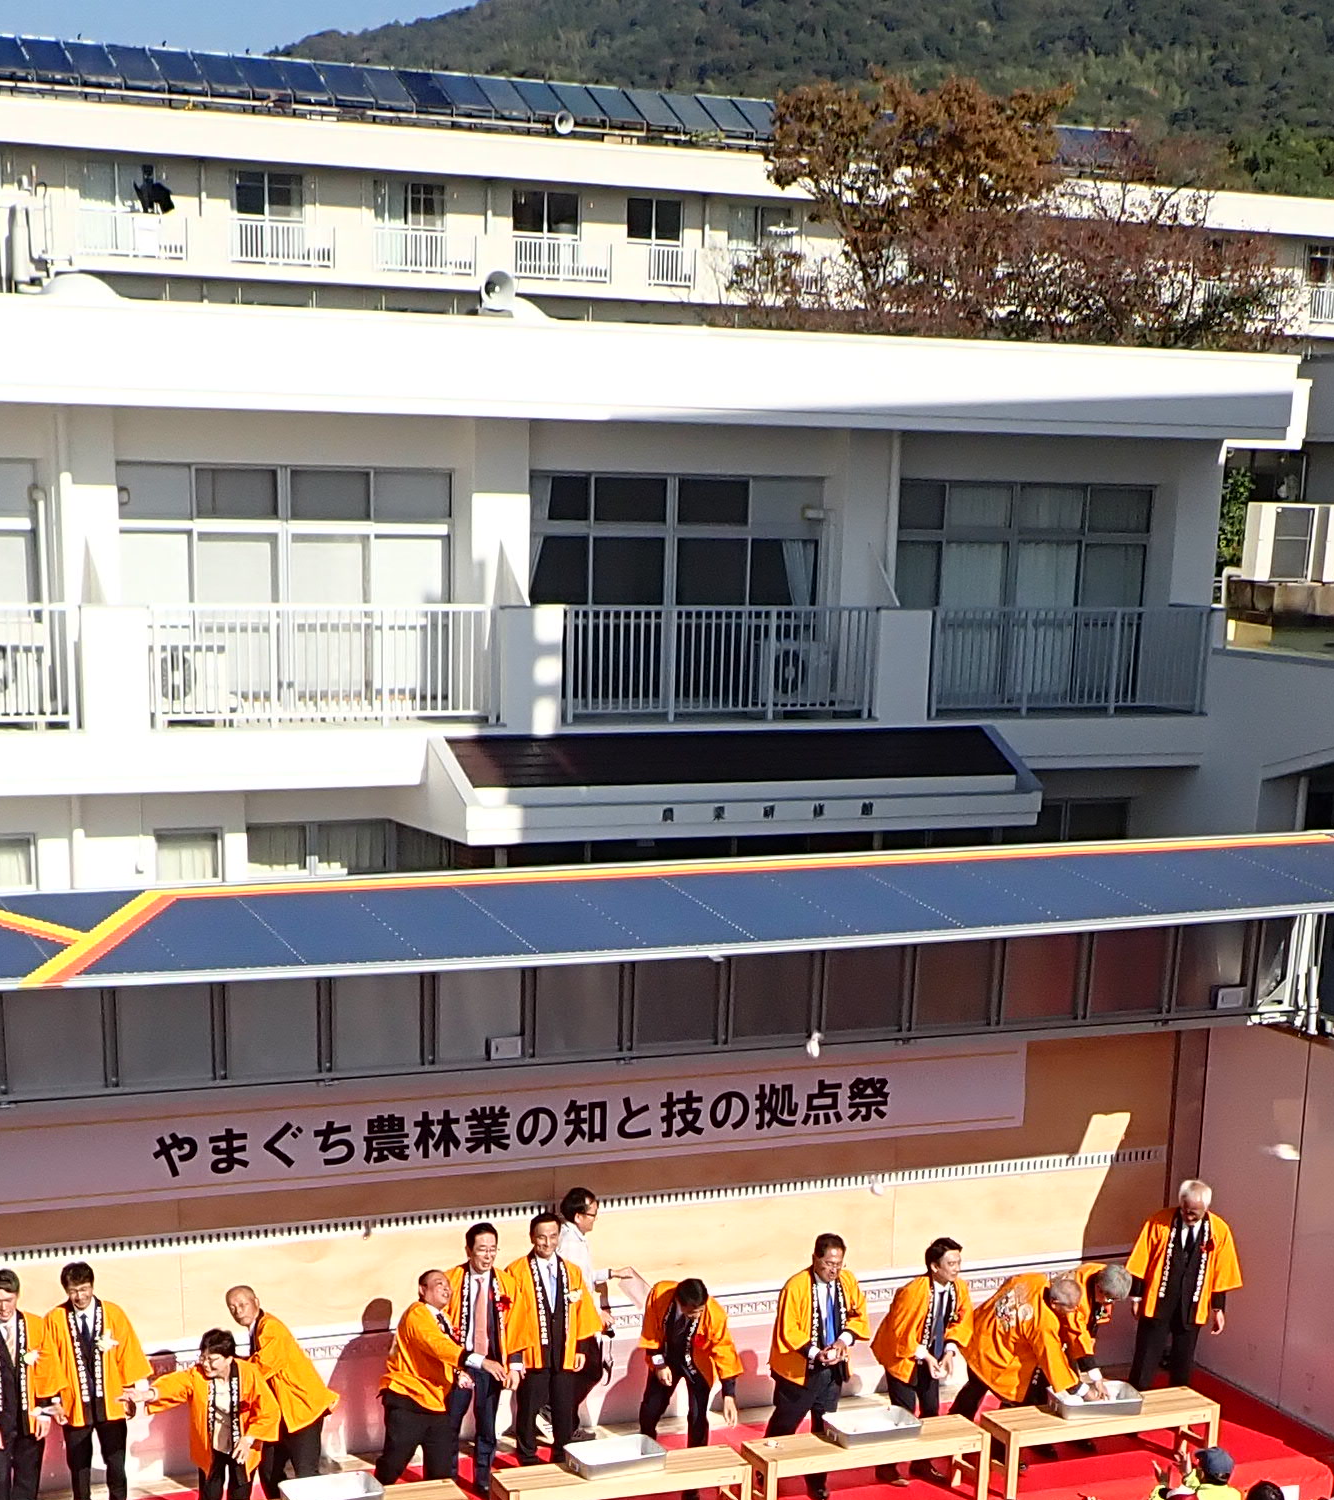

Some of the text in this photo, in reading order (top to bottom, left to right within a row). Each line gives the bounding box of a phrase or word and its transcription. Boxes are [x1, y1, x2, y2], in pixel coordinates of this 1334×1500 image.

[152, 1076, 891, 1178] やまぐち農林業の知と技の拠点祭
